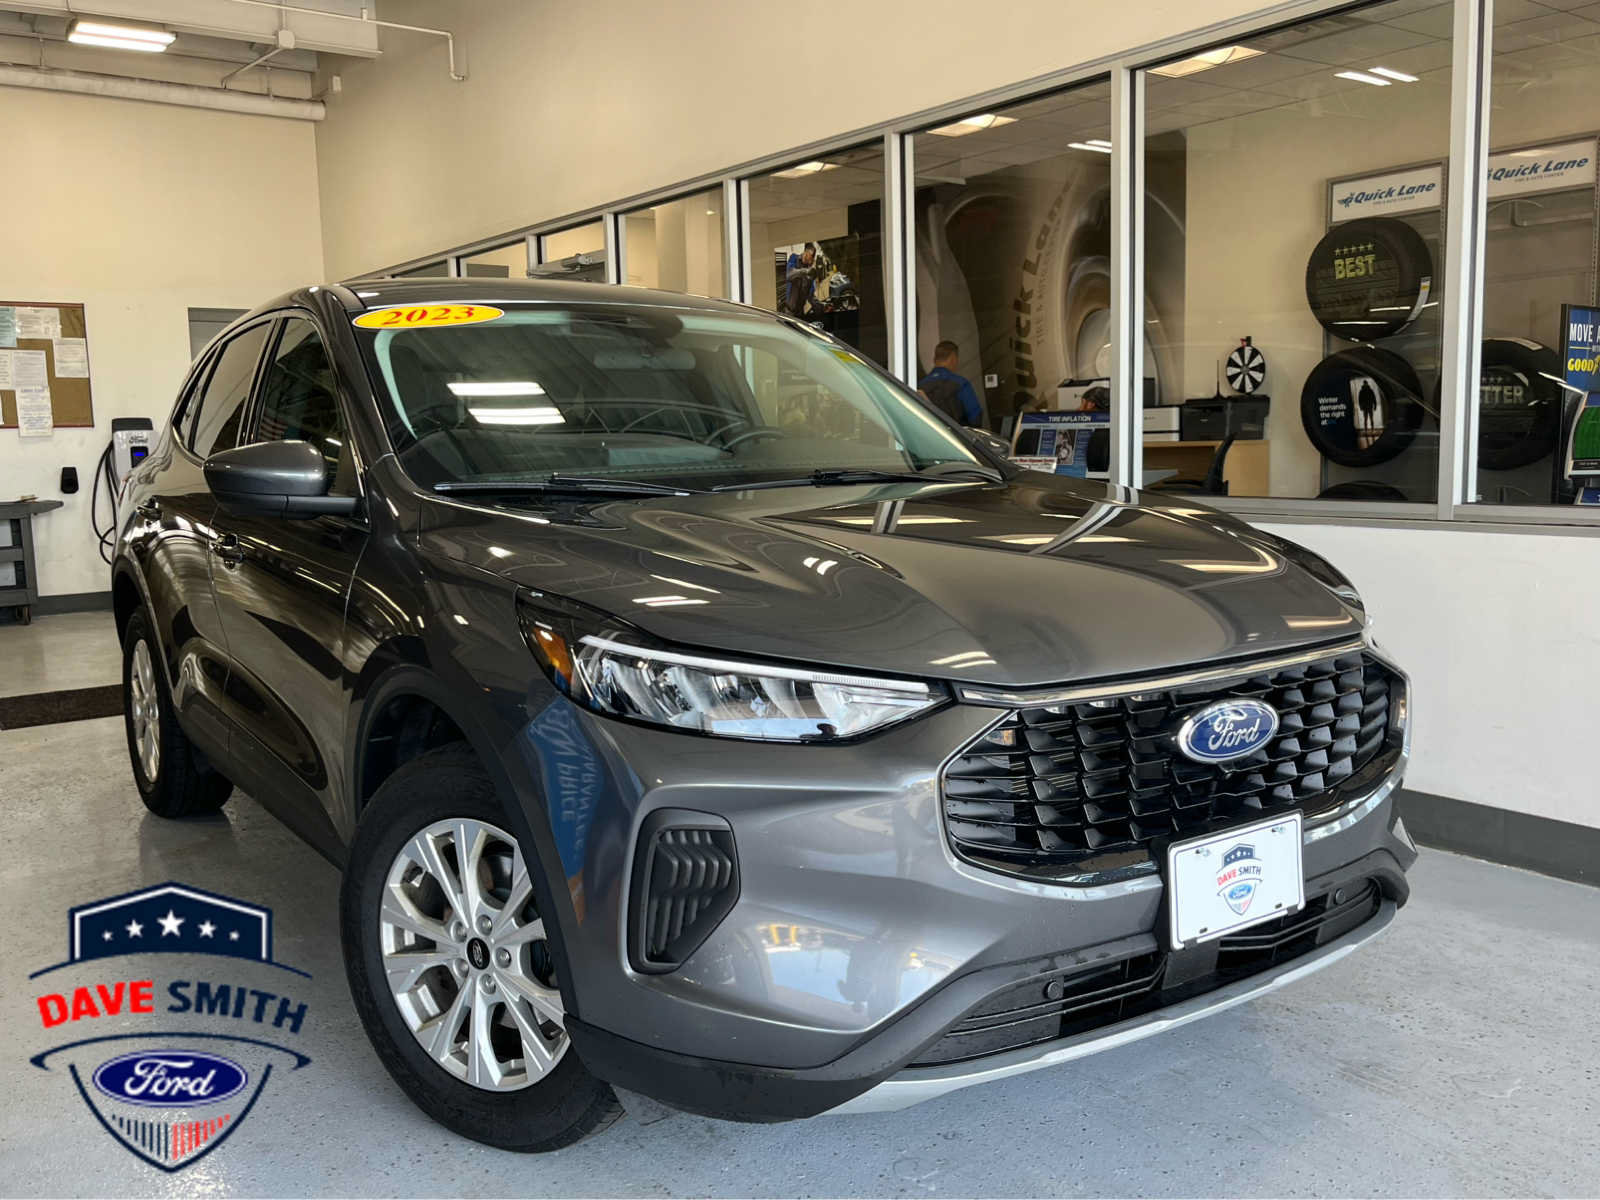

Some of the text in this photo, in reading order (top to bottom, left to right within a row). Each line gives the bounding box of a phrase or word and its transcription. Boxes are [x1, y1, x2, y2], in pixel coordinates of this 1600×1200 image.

[1493, 158, 1589, 181] Quick Lane
[1354, 187, 1396, 204] Quick
[1398, 182, 1436, 196] Lane
[1334, 254, 1376, 279] BEST
[382, 306, 475, 326] 2023
[1569, 323, 1594, 343] MOVE
[1048, 415, 1092, 423] TIRE INFLATION
[1208, 709, 1261, 751] Ford
[1216, 865, 1262, 887] DAVE SMITH
